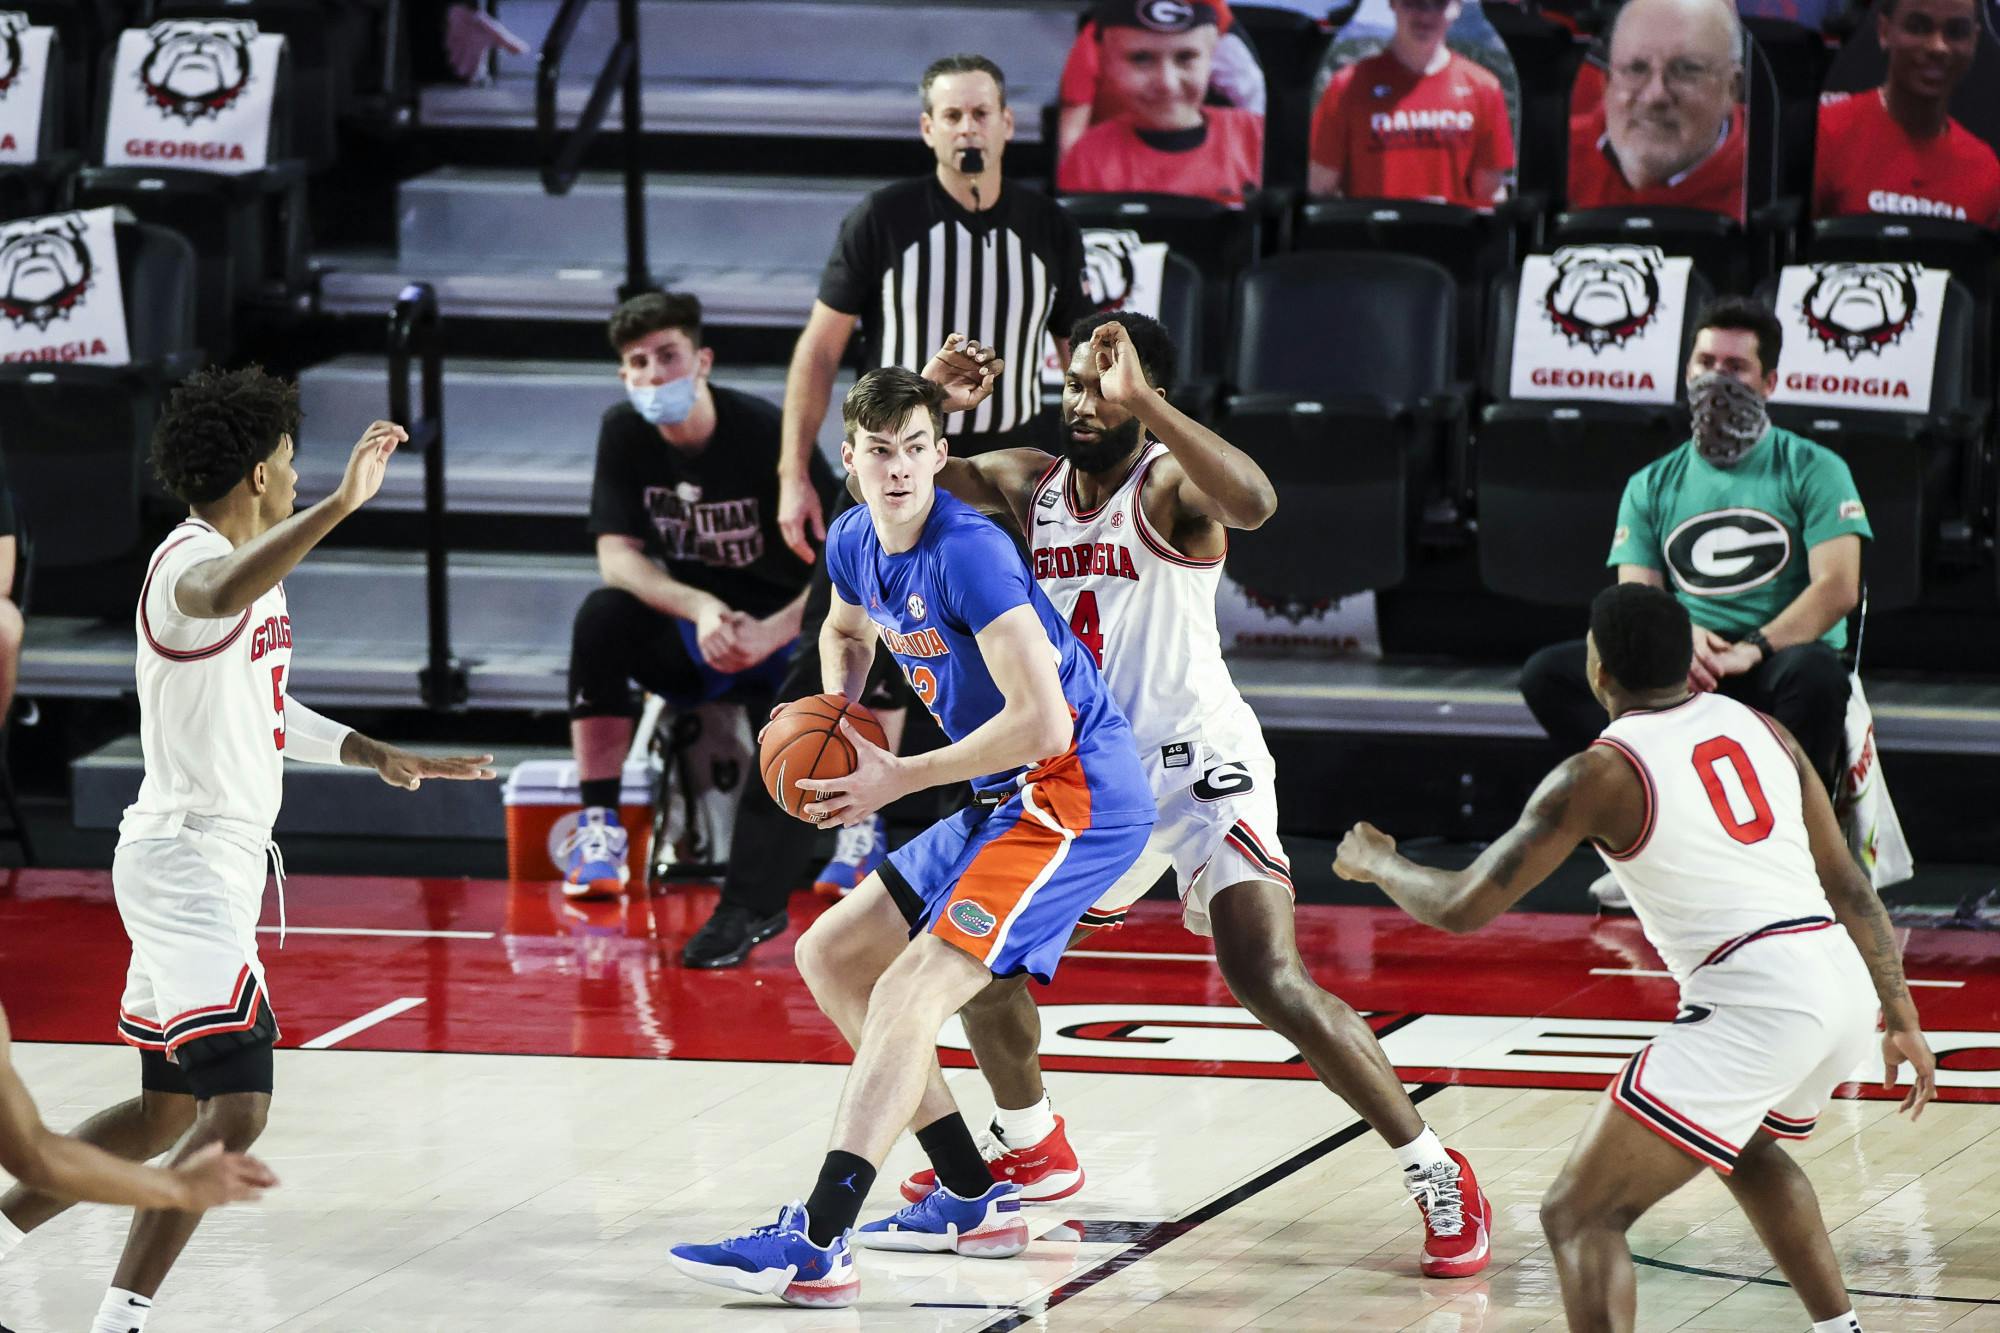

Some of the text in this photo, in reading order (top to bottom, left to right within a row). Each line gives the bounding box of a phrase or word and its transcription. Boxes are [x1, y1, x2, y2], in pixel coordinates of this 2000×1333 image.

[125, 138, 245, 161] GEORGIA
[3, 339, 107, 363] EORGIA
[1531, 368, 1655, 391] GEORGIA
[1786, 373, 1909, 399] GEORGIA
[1034, 543, 1139, 581] GEORGIA
[1070, 591, 1103, 670] 4
[271, 665, 286, 750] 5
[1168, 744, 1183, 754] 46
[1691, 735, 1775, 845] 0
